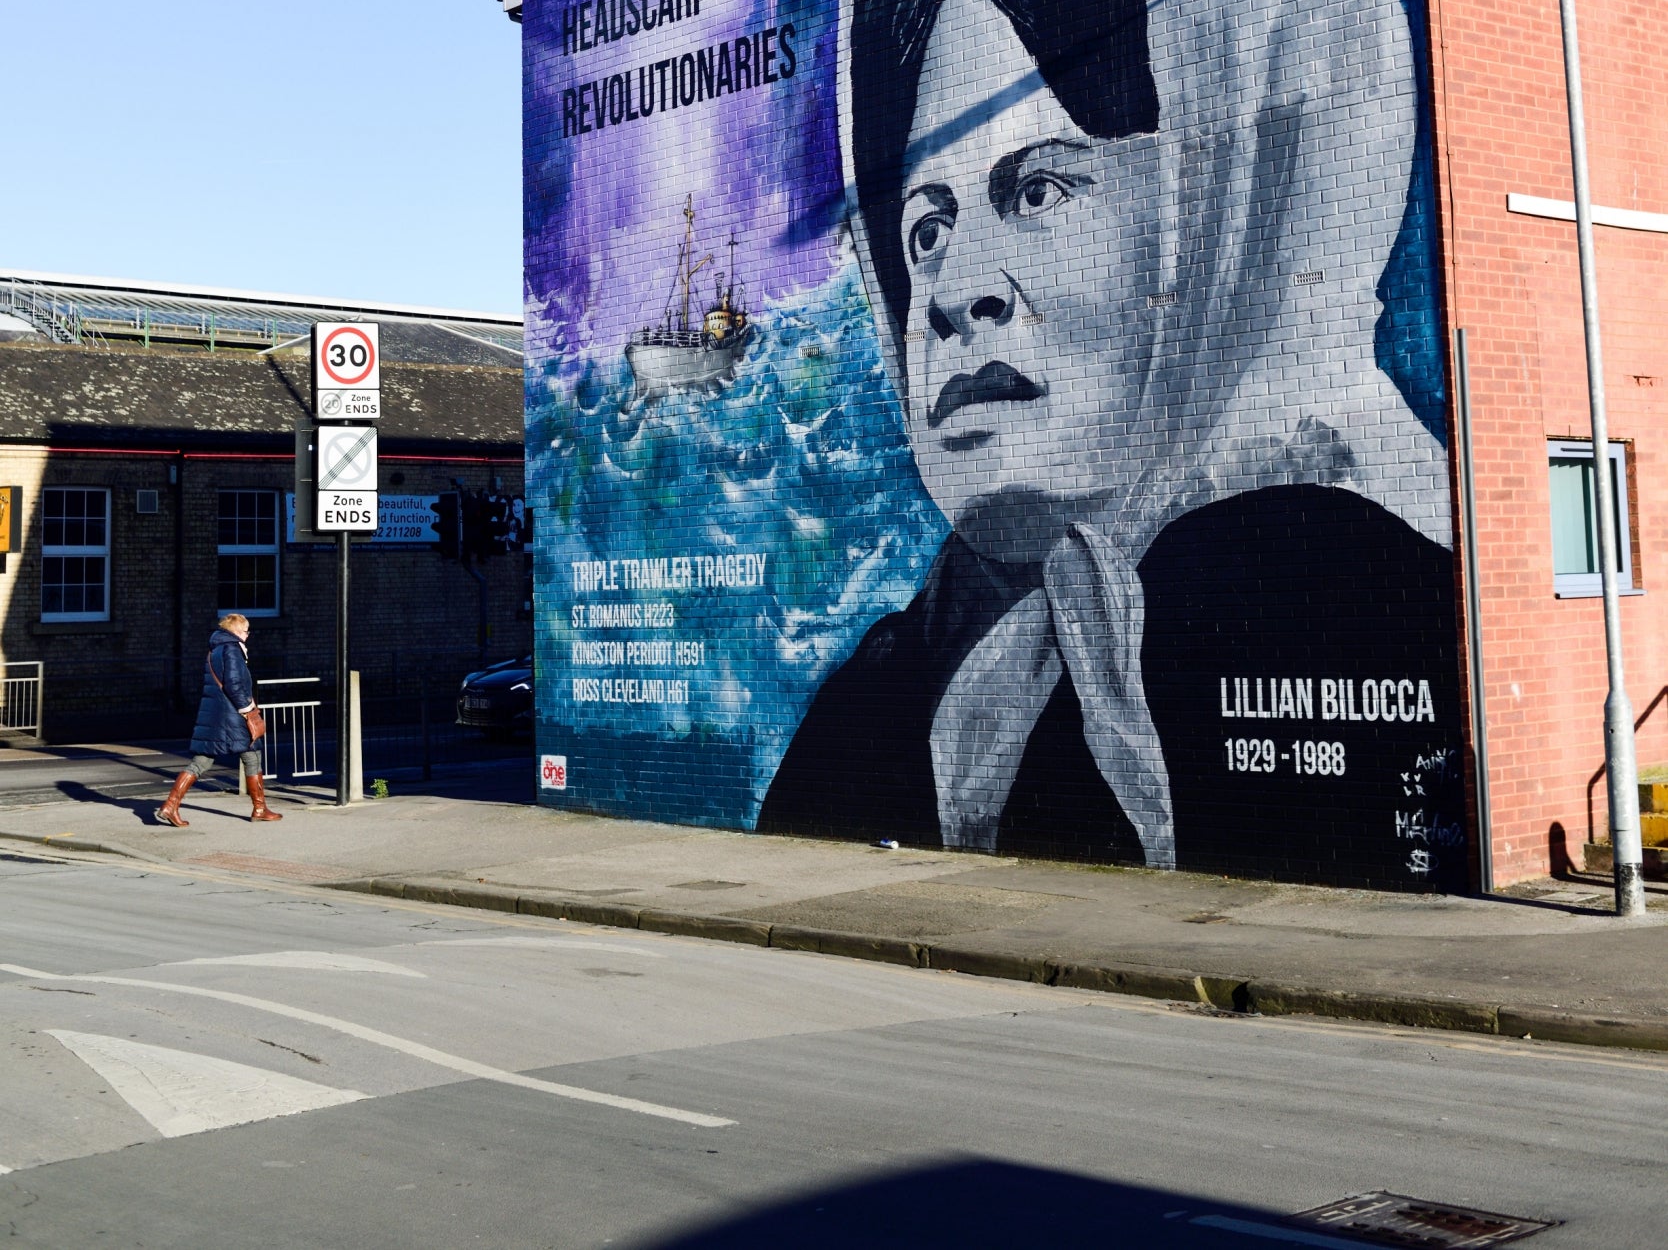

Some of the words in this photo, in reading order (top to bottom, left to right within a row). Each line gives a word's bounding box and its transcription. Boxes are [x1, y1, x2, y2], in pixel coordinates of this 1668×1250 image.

[562, 23, 797, 138] REVOLUTIONARIES
[330, 344, 367, 367] 30
[325, 398, 340, 410] 20
[351, 394, 371, 402] Zone
[345, 405, 377, 414] ENDS
[333, 495, 363, 506] Zone
[378, 498, 426, 510] beautiful,
[325, 511, 371, 523] ENDS
[390, 512, 430, 523] function
[386, 526, 421, 537] 211208
[571, 560, 619, 592] TRIPLE
[622, 556, 691, 590] TRAWLER
[695, 553, 767, 587] TRAGEDY
[572, 605, 587, 628] ST.
[589, 604, 641, 628] ROMANUS
[644, 603, 674, 628] H223
[572, 641, 624, 665] KINGSTON
[627, 641, 673, 665] PERIDOT
[675, 641, 705, 666] H591
[573, 678, 599, 702] ROSS
[602, 679, 665, 703] CLEVELAND
[667, 680, 689, 704] H61
[1220, 677, 1314, 719] LILLIAN
[1320, 678, 1435, 722] BILOCCA
[543, 766, 565, 780] one
